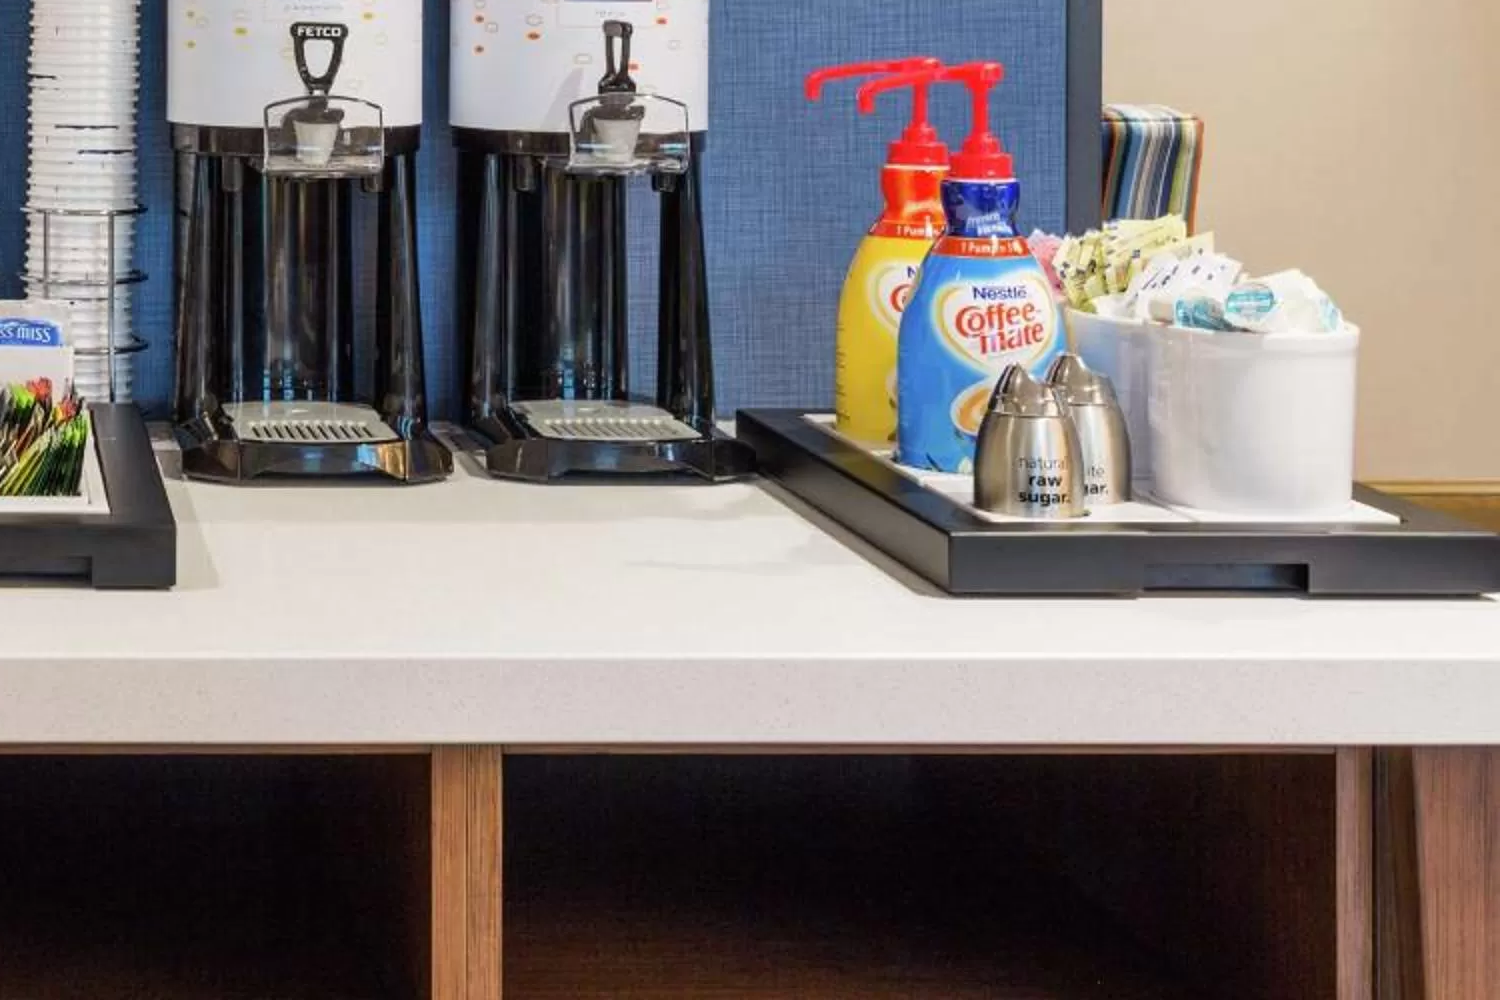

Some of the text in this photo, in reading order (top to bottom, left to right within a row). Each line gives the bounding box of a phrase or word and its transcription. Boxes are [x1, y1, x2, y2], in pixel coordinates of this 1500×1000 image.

[297, 25, 342, 37] FETCO
[980, 322, 1044, 354] mate
[1086, 466, 1105, 477] ite
[1028, 475, 1062, 487] raw
[1018, 491, 1072, 507] sugar.
